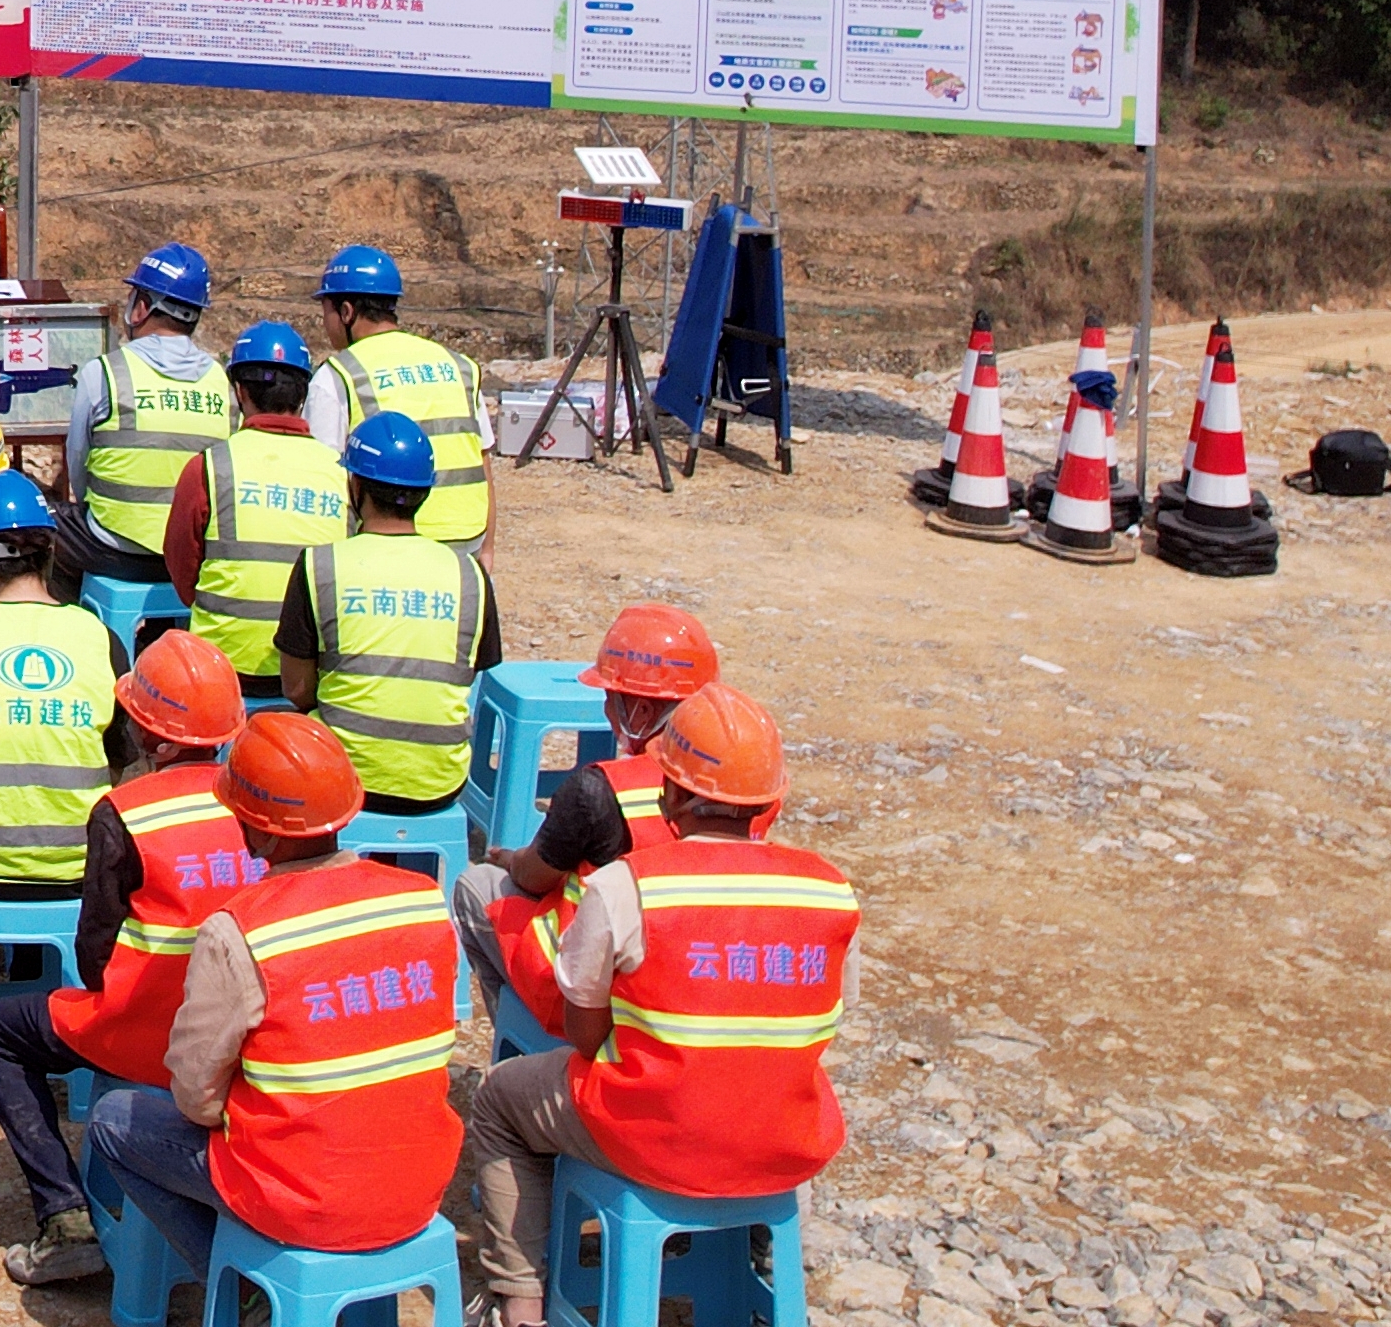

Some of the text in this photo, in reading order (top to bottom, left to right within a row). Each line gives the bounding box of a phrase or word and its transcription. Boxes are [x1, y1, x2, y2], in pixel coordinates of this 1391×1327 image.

[374, 361, 458, 387] 云南建投
[134, 388, 224, 416] 云南建投
[238, 480, 343, 520] 云南建投
[341, 586, 456, 622] 云南建投
[174, 848, 269, 890] 云南建
[684, 941, 829, 985] 云南建投
[302, 960, 437, 1023] 云南建投
